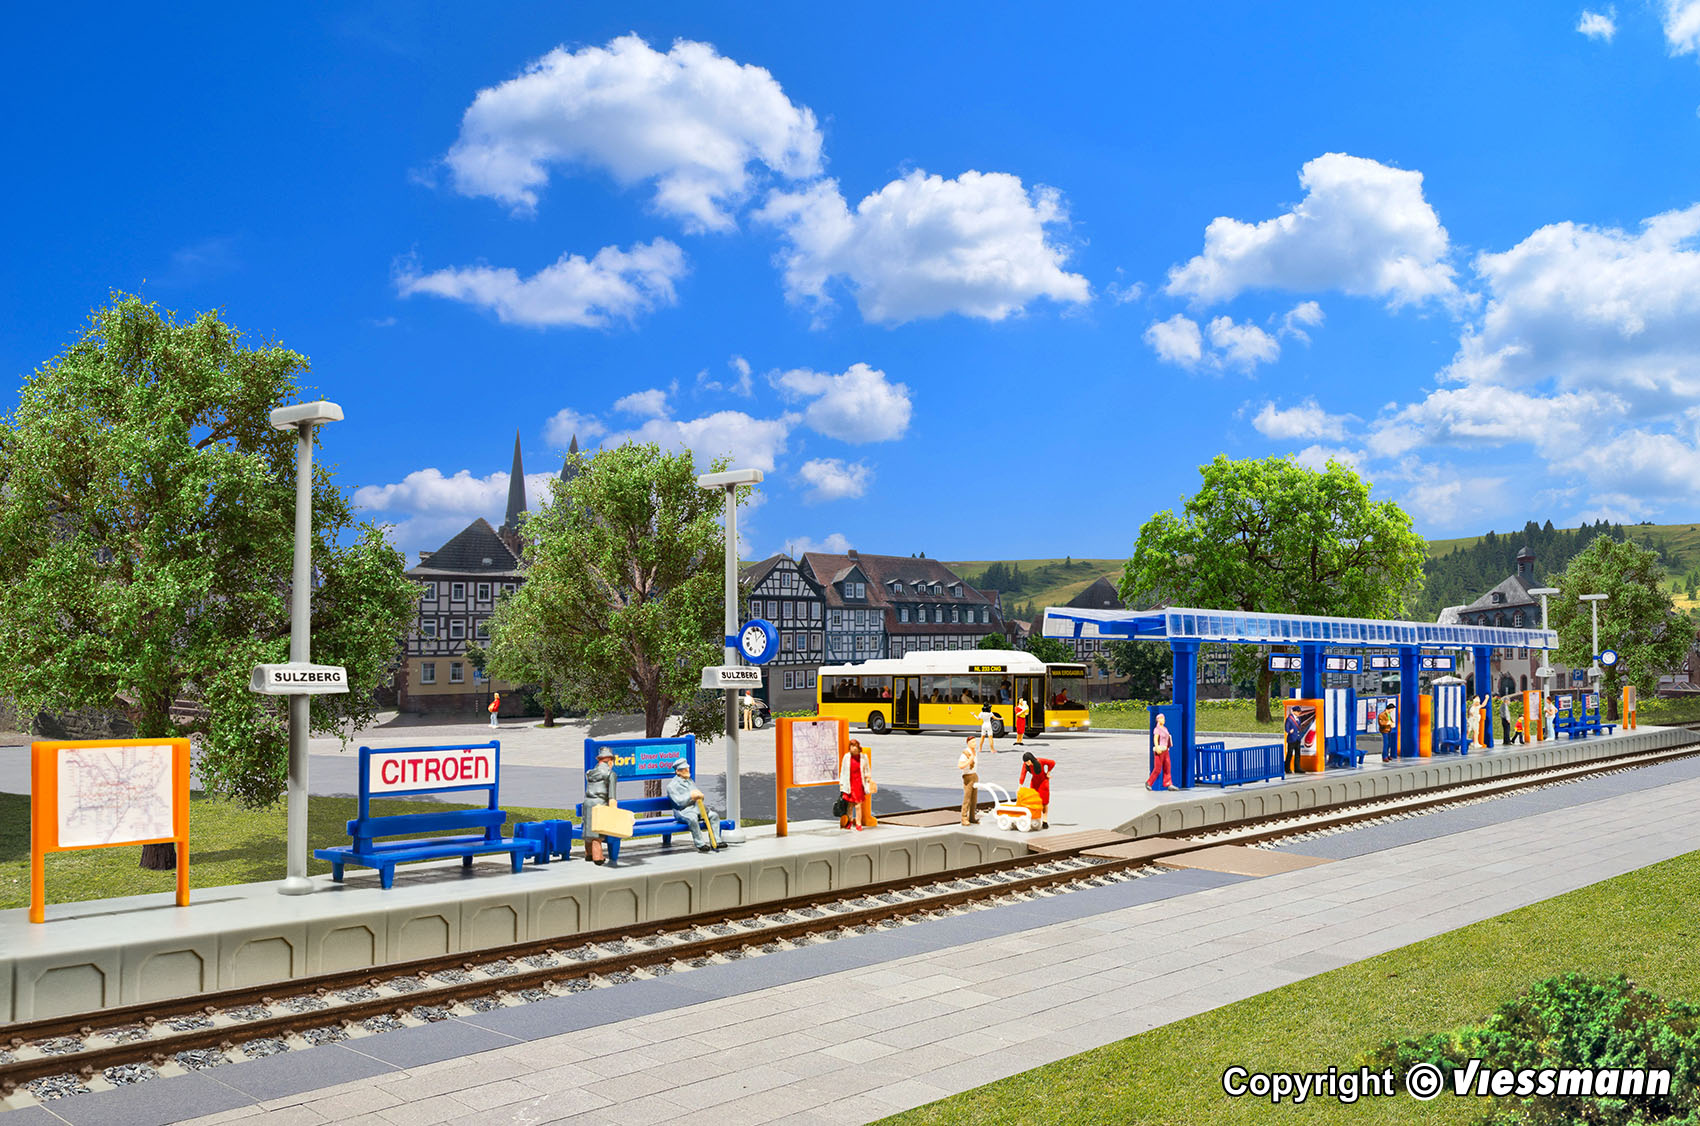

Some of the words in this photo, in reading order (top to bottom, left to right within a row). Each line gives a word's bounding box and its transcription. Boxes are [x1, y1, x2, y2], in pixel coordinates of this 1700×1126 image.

[274, 672, 341, 682] SULZBERG
[721, 671, 758, 679] SULZBERG
[659, 751, 680, 759] Vorbild
[615, 753, 636, 766] bri
[659, 761, 674, 769] Origi
